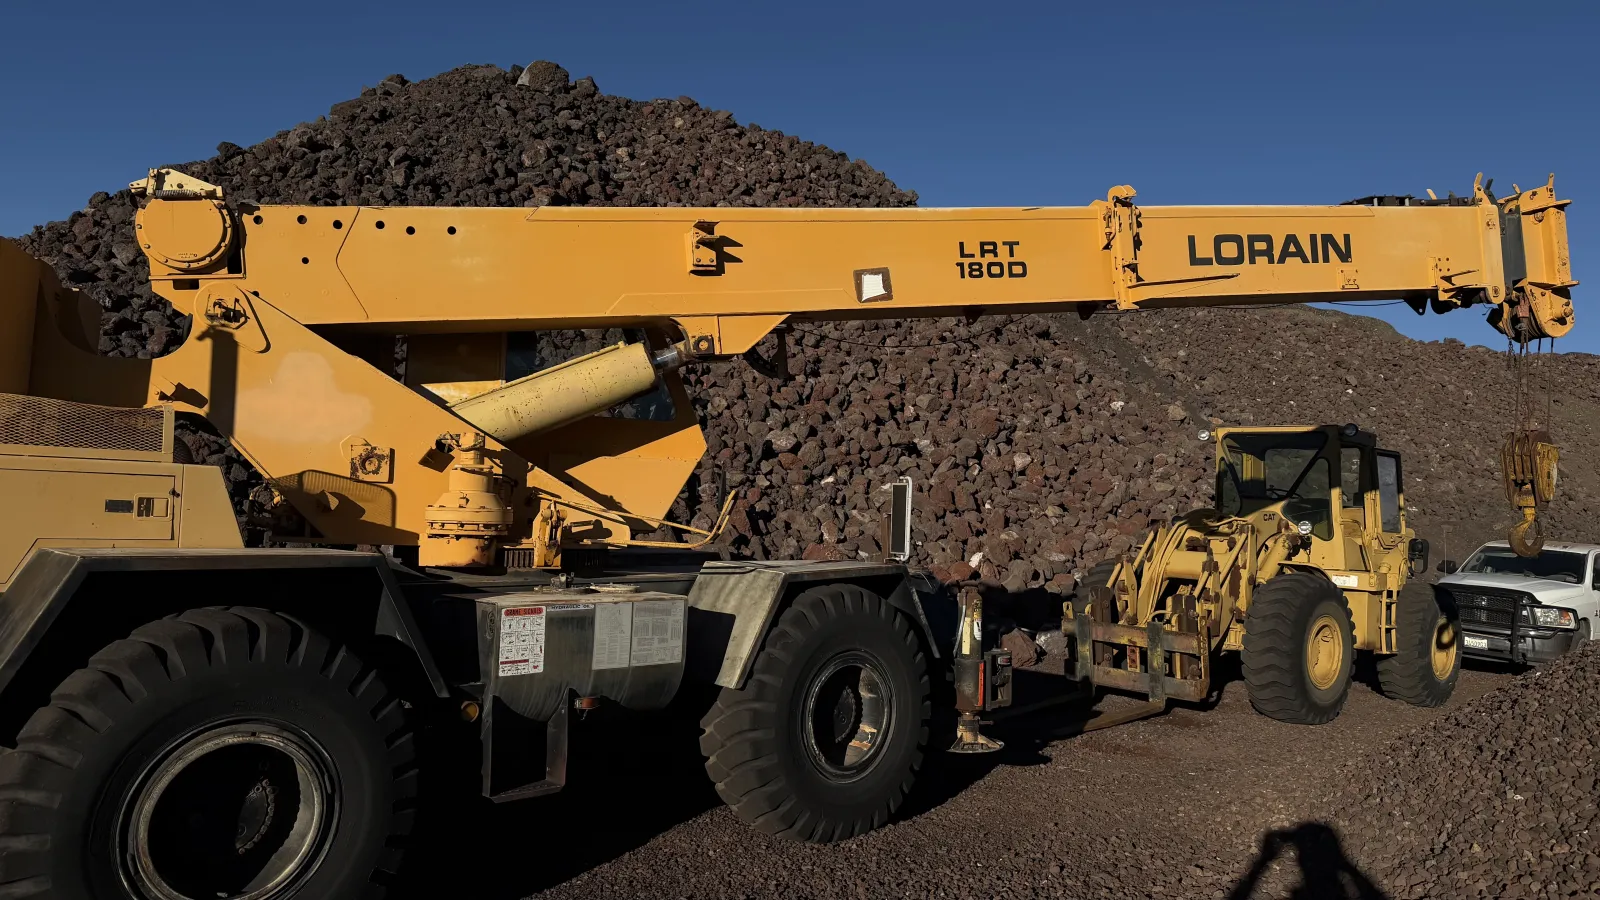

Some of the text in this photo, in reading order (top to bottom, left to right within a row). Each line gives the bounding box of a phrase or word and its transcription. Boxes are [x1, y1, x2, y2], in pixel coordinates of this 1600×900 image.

[959, 241, 1020, 258] LRT
[1187, 234, 1352, 266] LORAIN
[955, 261, 1027, 279] 180D
[1263, 513, 1276, 522] CAT
